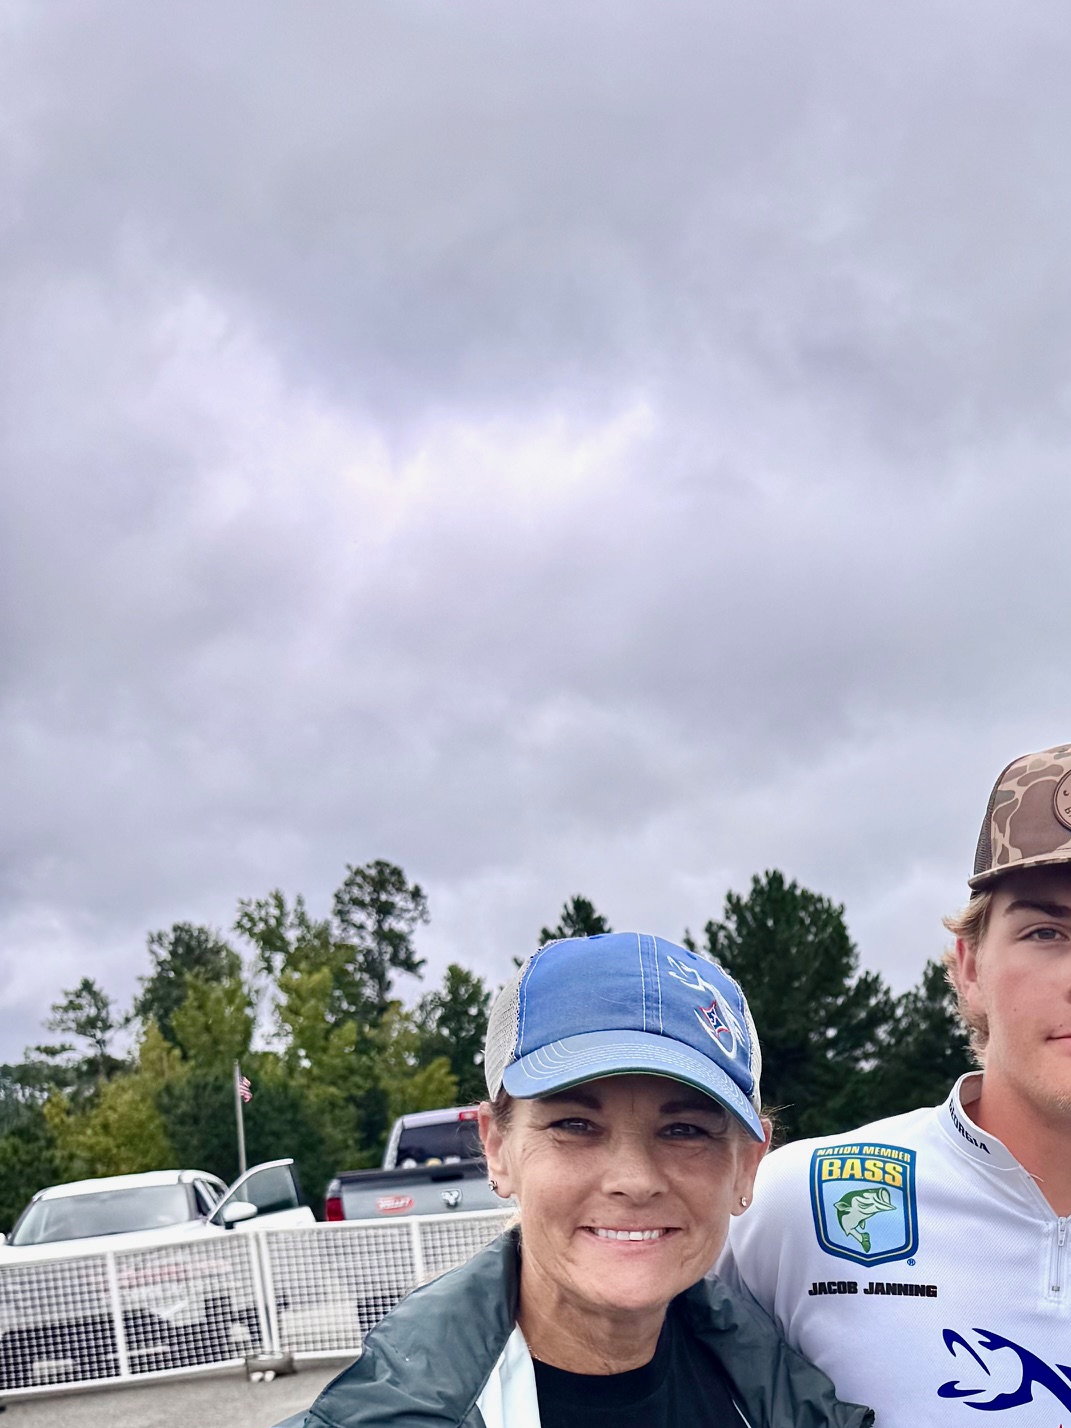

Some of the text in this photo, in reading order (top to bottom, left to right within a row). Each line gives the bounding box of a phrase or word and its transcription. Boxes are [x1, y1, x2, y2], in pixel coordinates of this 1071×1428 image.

[816, 1146, 911, 1162] NATION MEMBER
[808, 1281, 938, 1298] JACOB JANNING
